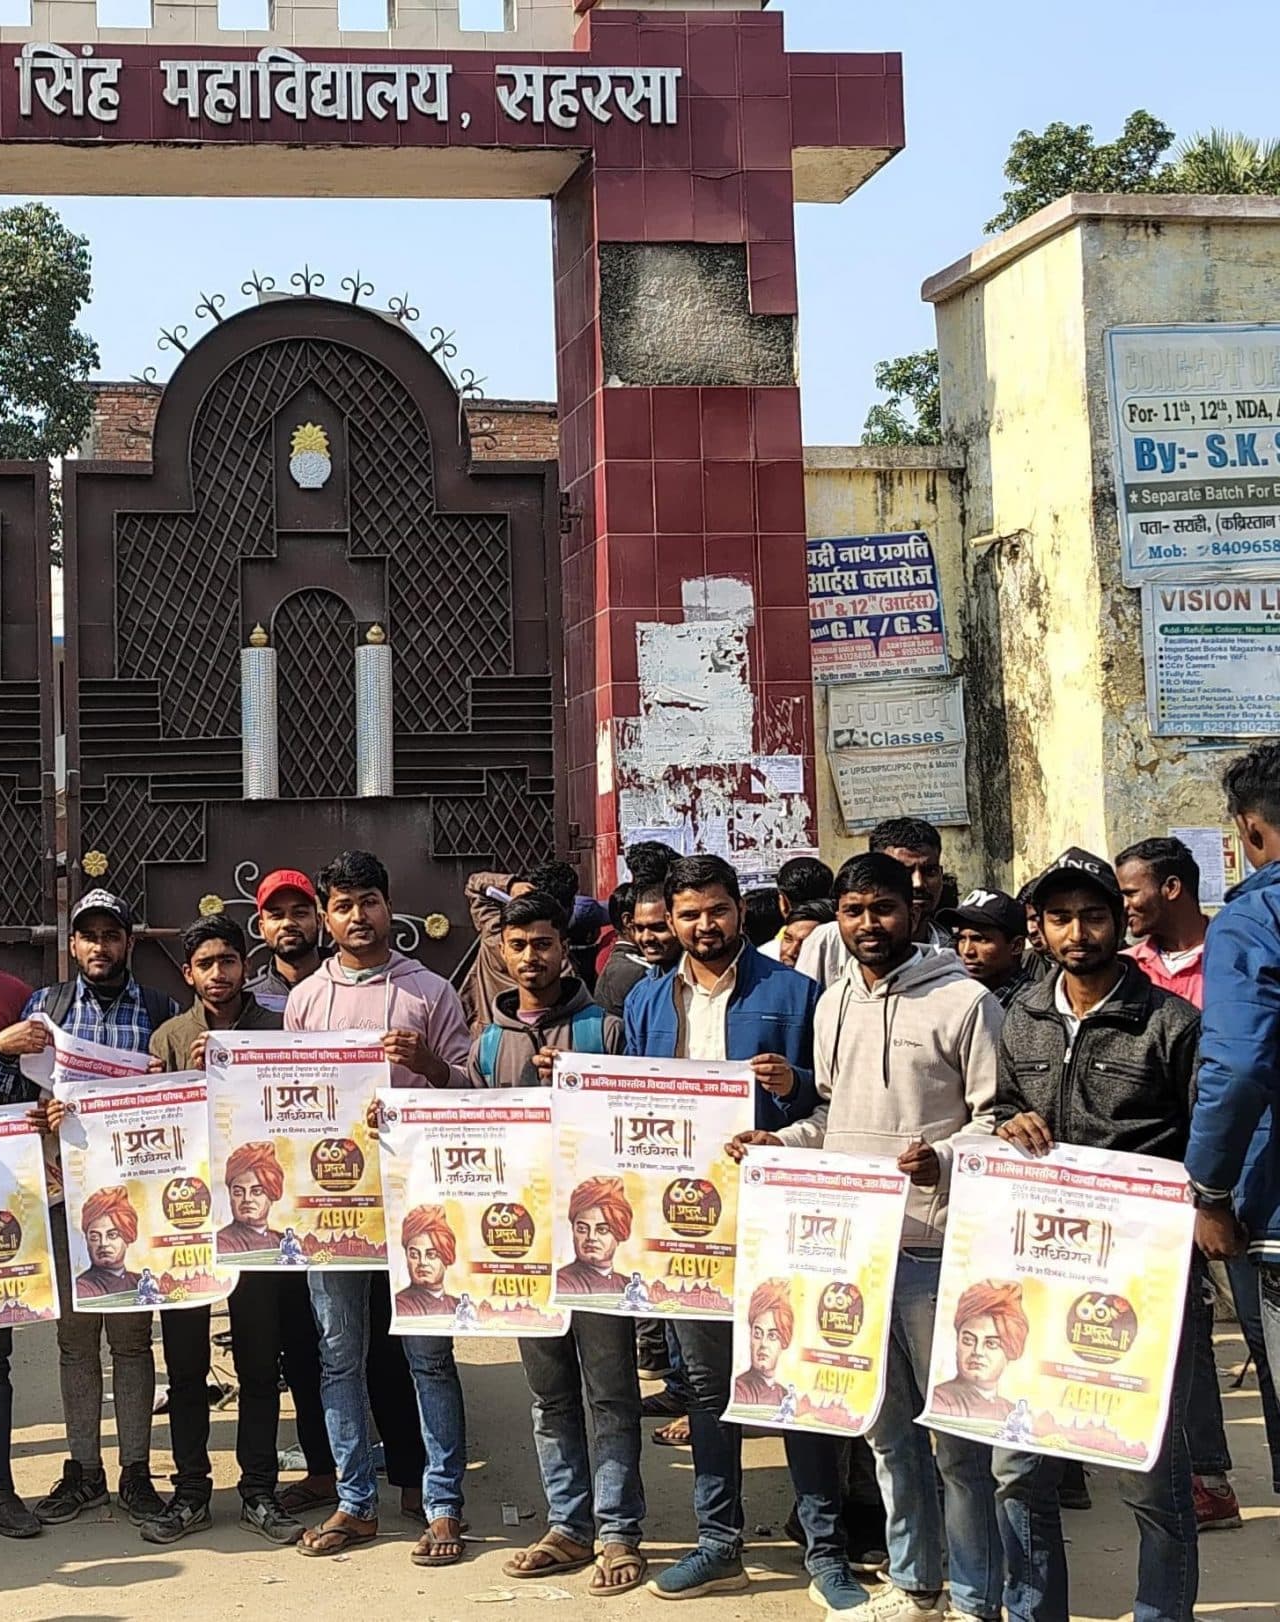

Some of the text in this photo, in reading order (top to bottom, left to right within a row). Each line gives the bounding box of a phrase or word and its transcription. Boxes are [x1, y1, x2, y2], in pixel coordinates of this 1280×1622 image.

[14, 41, 122, 122] सिंह
[160, 46, 471, 130] महाविद्यालय,
[495, 65, 682, 127] सहरसा
[1236, 399, 1273, 421] NDA,
[1206, 433, 1269, 468] S.K.
[1142, 484, 1270, 506] Separate Batch For
[878, 535, 928, 562] प्रगति
[1148, 545, 1186, 559] Mob:
[835, 603, 847, 616] &
[1161, 588, 1251, 611] VISION
[831, 619, 876, 639] G.K.
[894, 615, 938, 634] G.S.
[871, 730, 944, 746] Classes
[276, 1080, 325, 1108] प्रांत
[125, 1124, 171, 1152] प्रांत
[627, 1111, 681, 1144] प्रांत
[445, 1141, 493, 1171] प्रांत
[320, 1209, 367, 1229] ABVP
[800, 1209, 837, 1244] प्रांत
[1030, 1207, 1092, 1247] प्रांत
[670, 1257, 721, 1278] ABVP
[494, 1277, 537, 1296] ABVP
